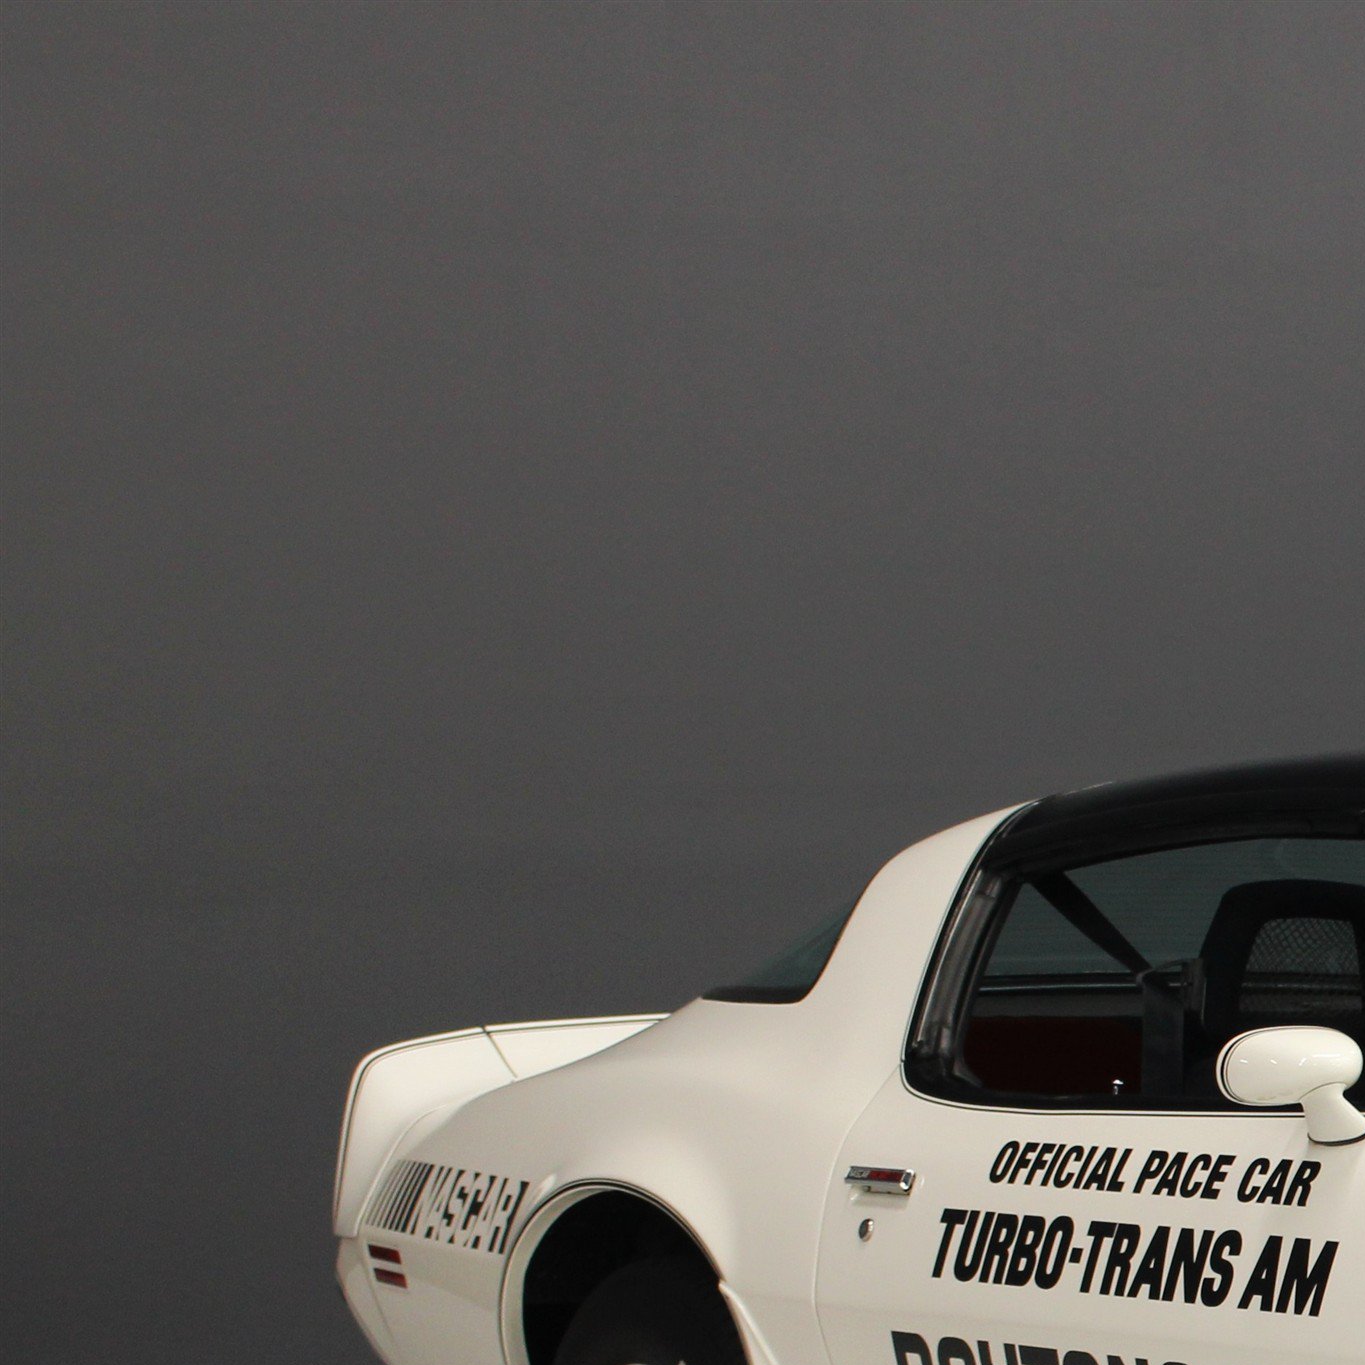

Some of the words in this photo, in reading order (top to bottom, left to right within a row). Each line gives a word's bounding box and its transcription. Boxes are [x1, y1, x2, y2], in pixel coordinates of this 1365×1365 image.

[989, 1140, 1133, 1192] OFFICIAL
[1134, 1150, 1237, 1200] PACE
[1237, 1158, 1322, 1208] CAR
[931, 1208, 1243, 1308] TURBO-TRANS
[1237, 1235, 1340, 1317] AM
